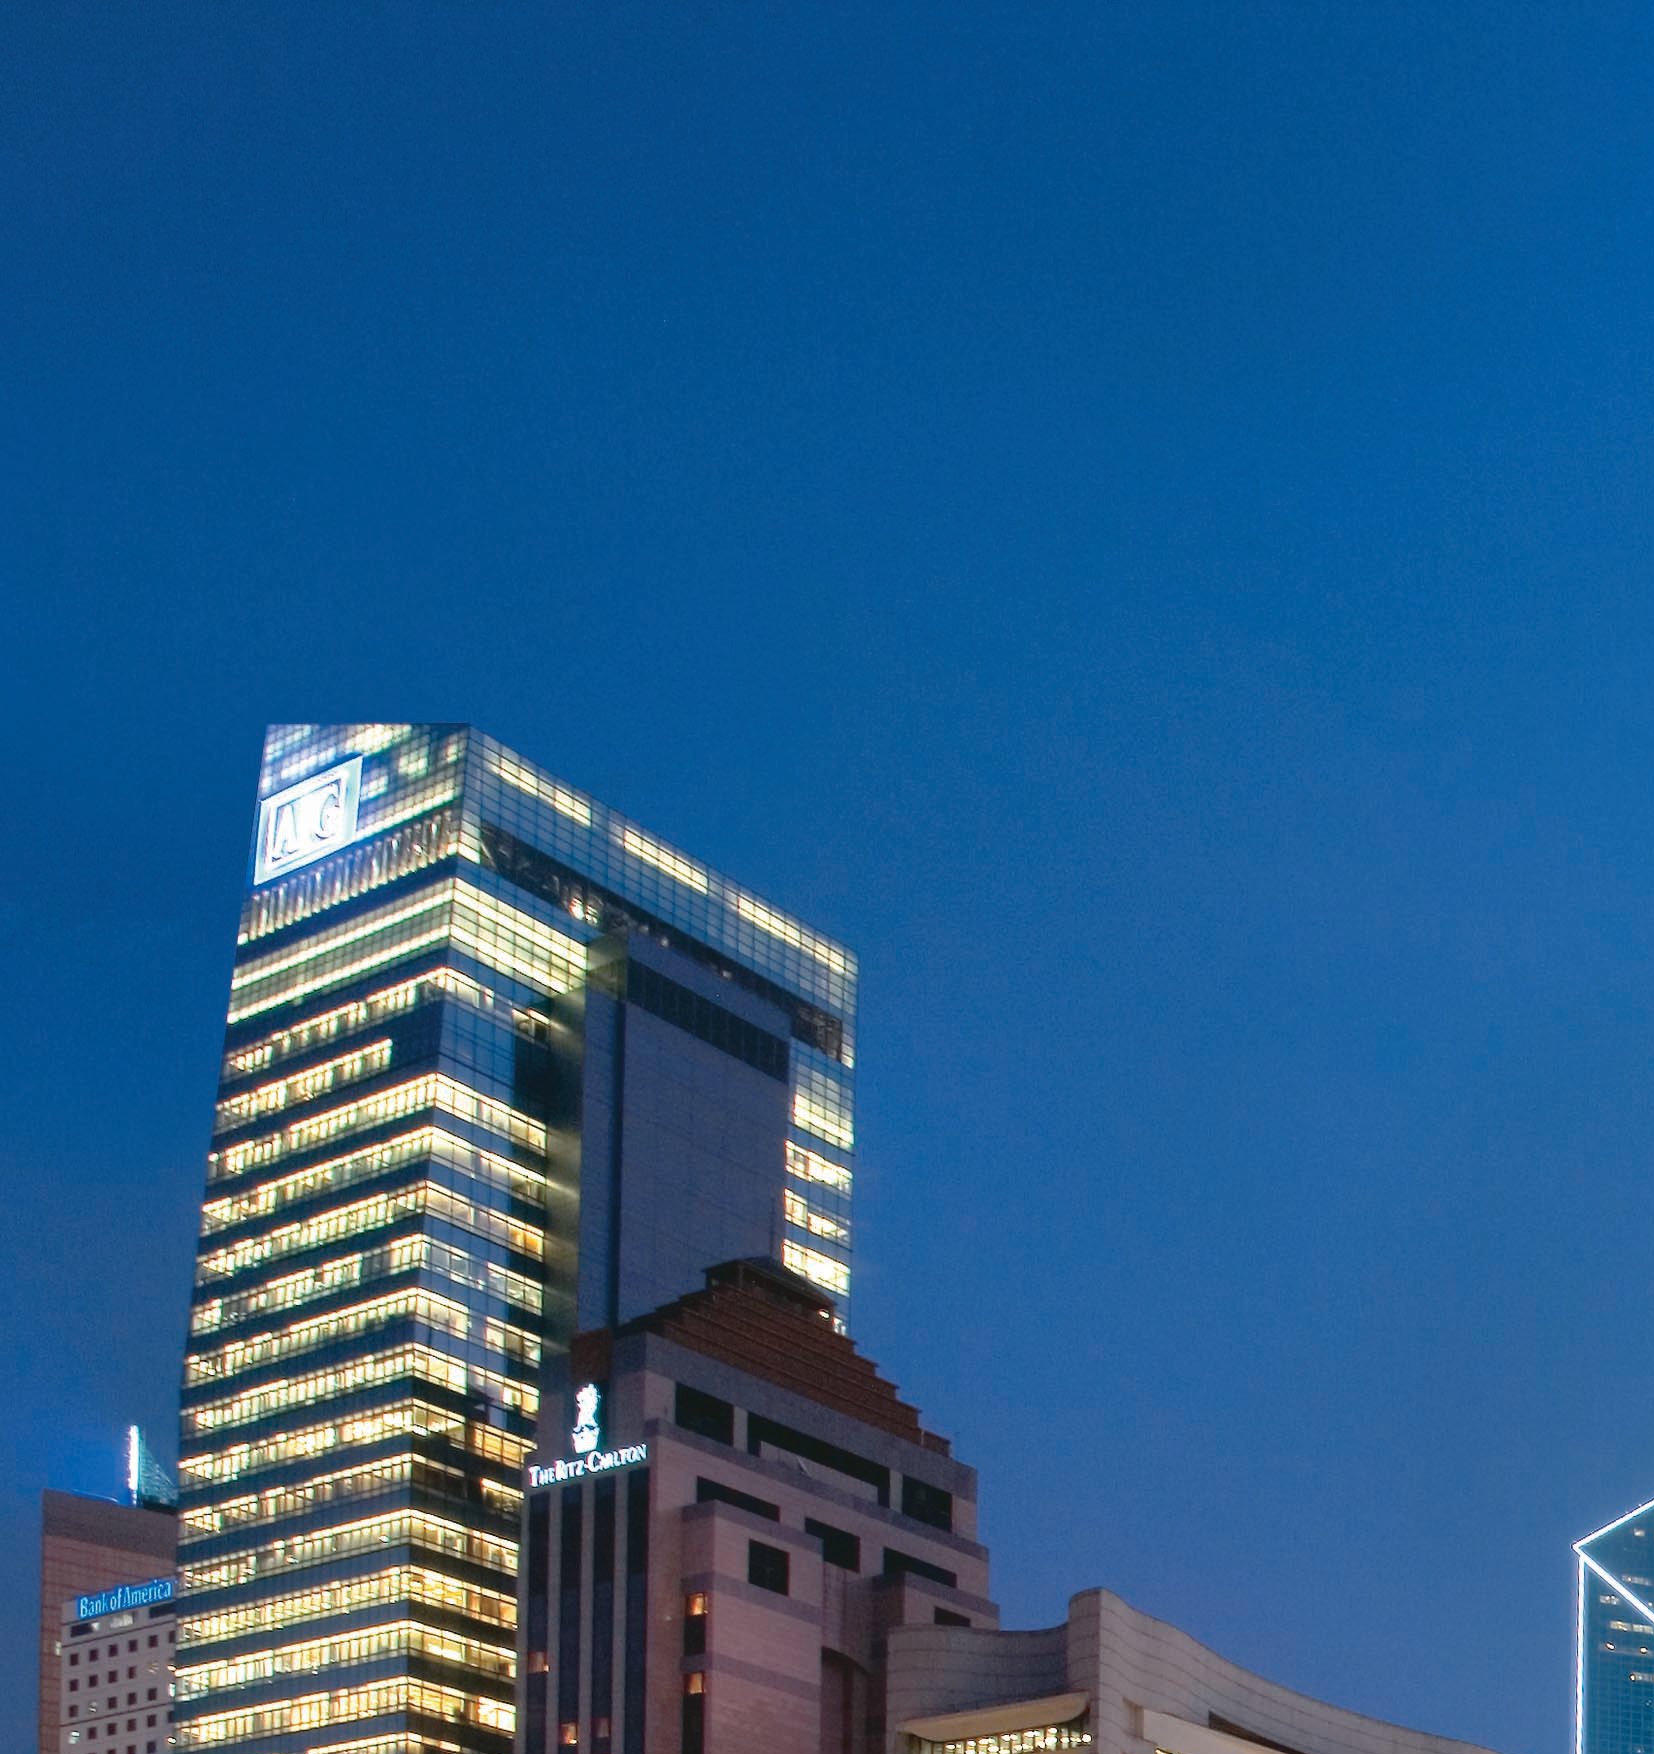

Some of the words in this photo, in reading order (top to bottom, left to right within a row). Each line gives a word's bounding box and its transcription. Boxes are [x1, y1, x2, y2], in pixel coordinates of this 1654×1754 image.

[271, 780, 342, 862] AG
[79, 1593, 109, 1619] Bank
[109, 1587, 123, 1612] of
[122, 1578, 172, 1609] America
